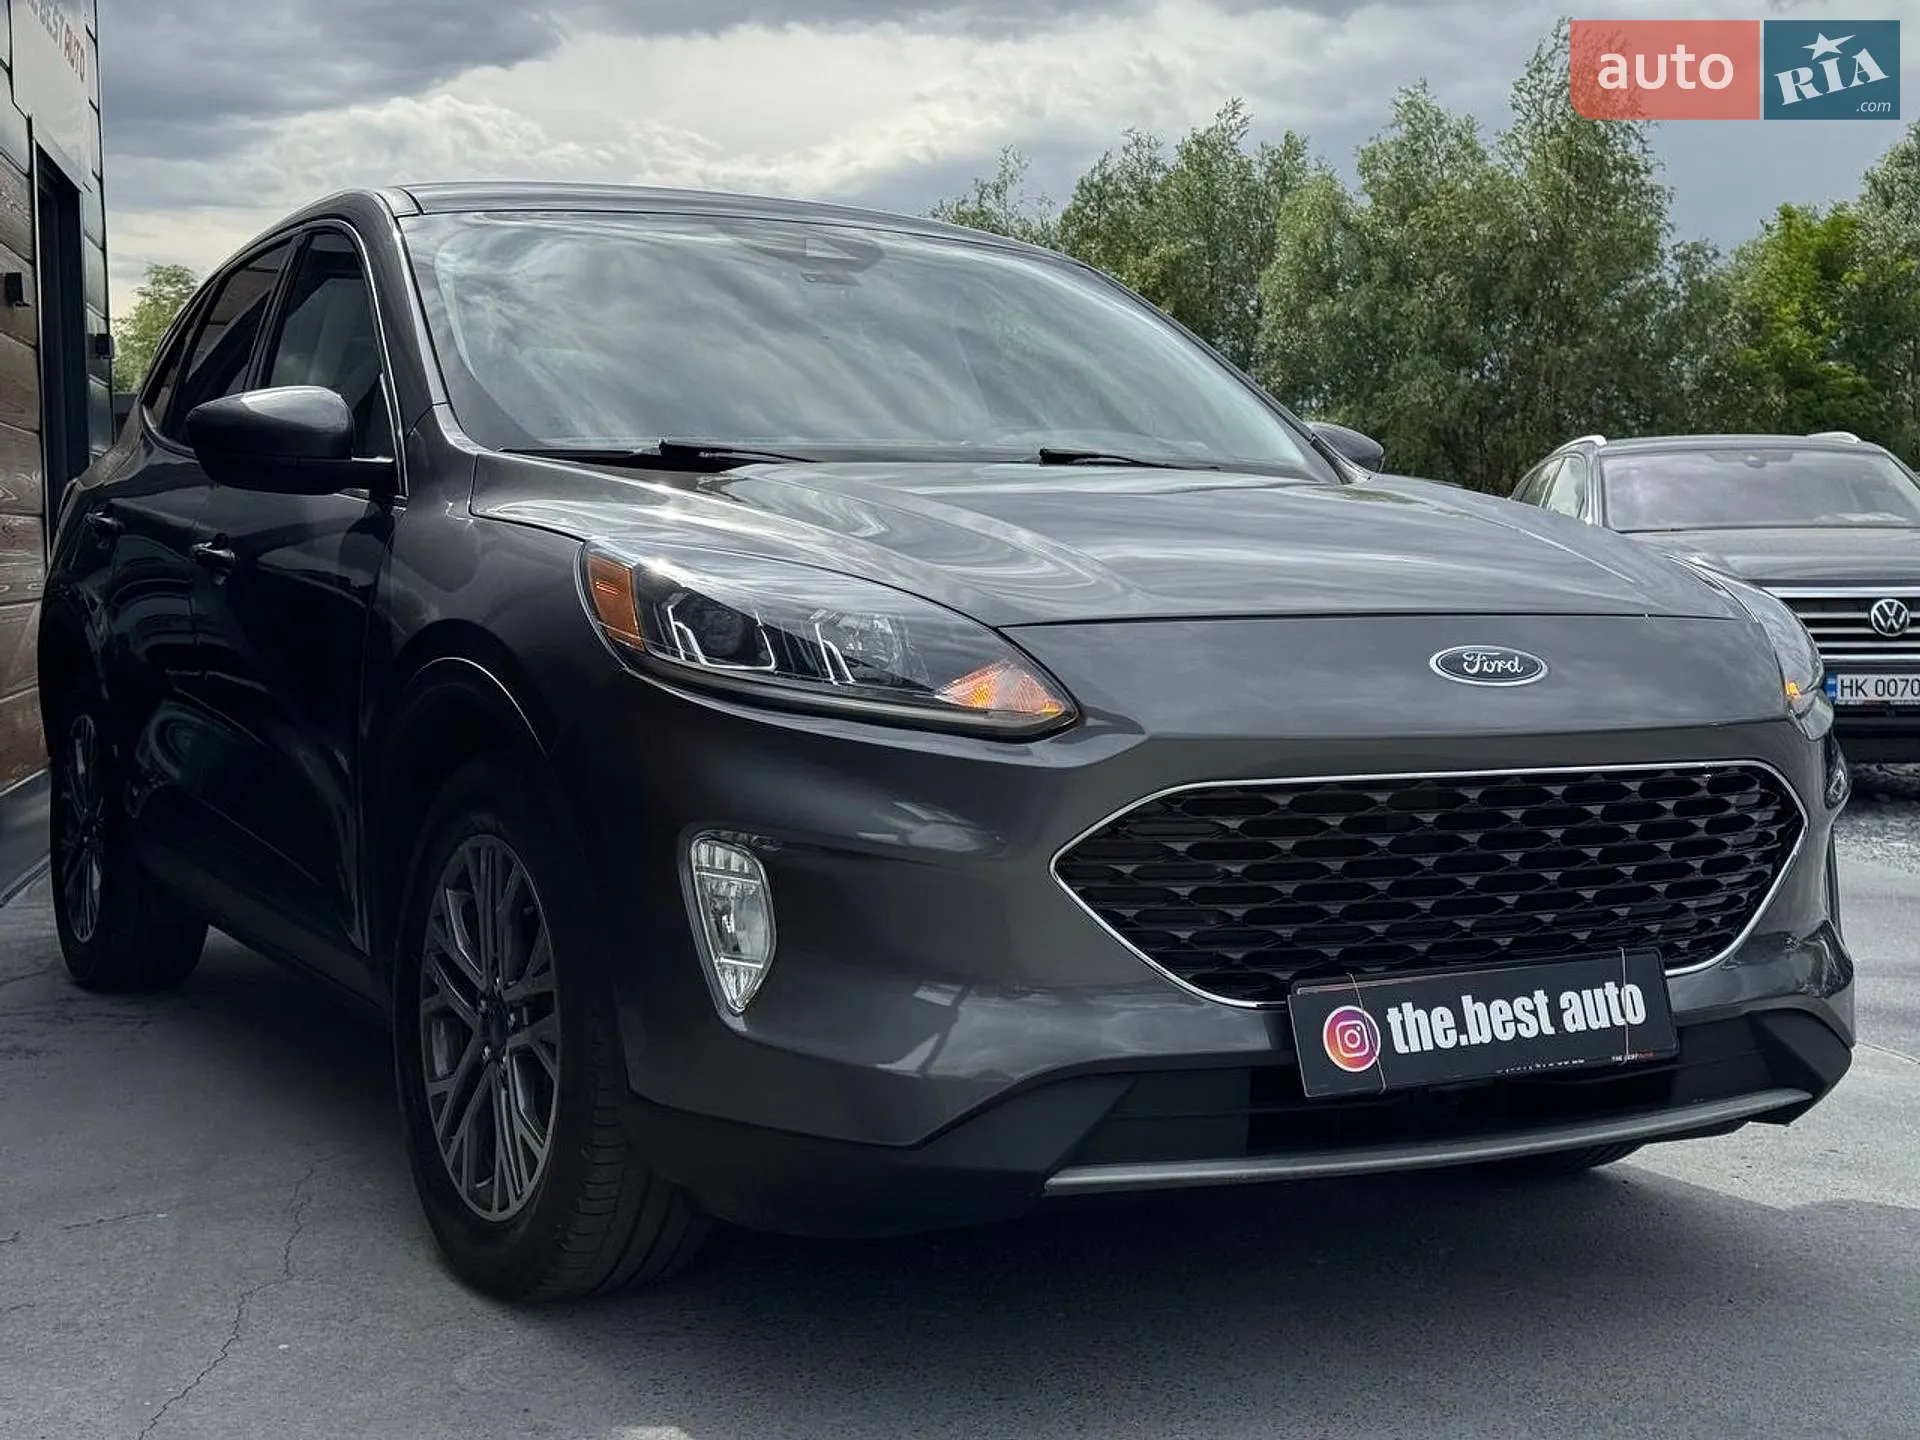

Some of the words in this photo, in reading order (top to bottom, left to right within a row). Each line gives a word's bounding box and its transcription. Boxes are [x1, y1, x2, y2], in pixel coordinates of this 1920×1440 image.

[1462, 650, 1524, 674] Ford
[1840, 678, 1869, 697] HK
[1386, 990, 1555, 1054] the.best
[1559, 980, 1646, 1034] auto
